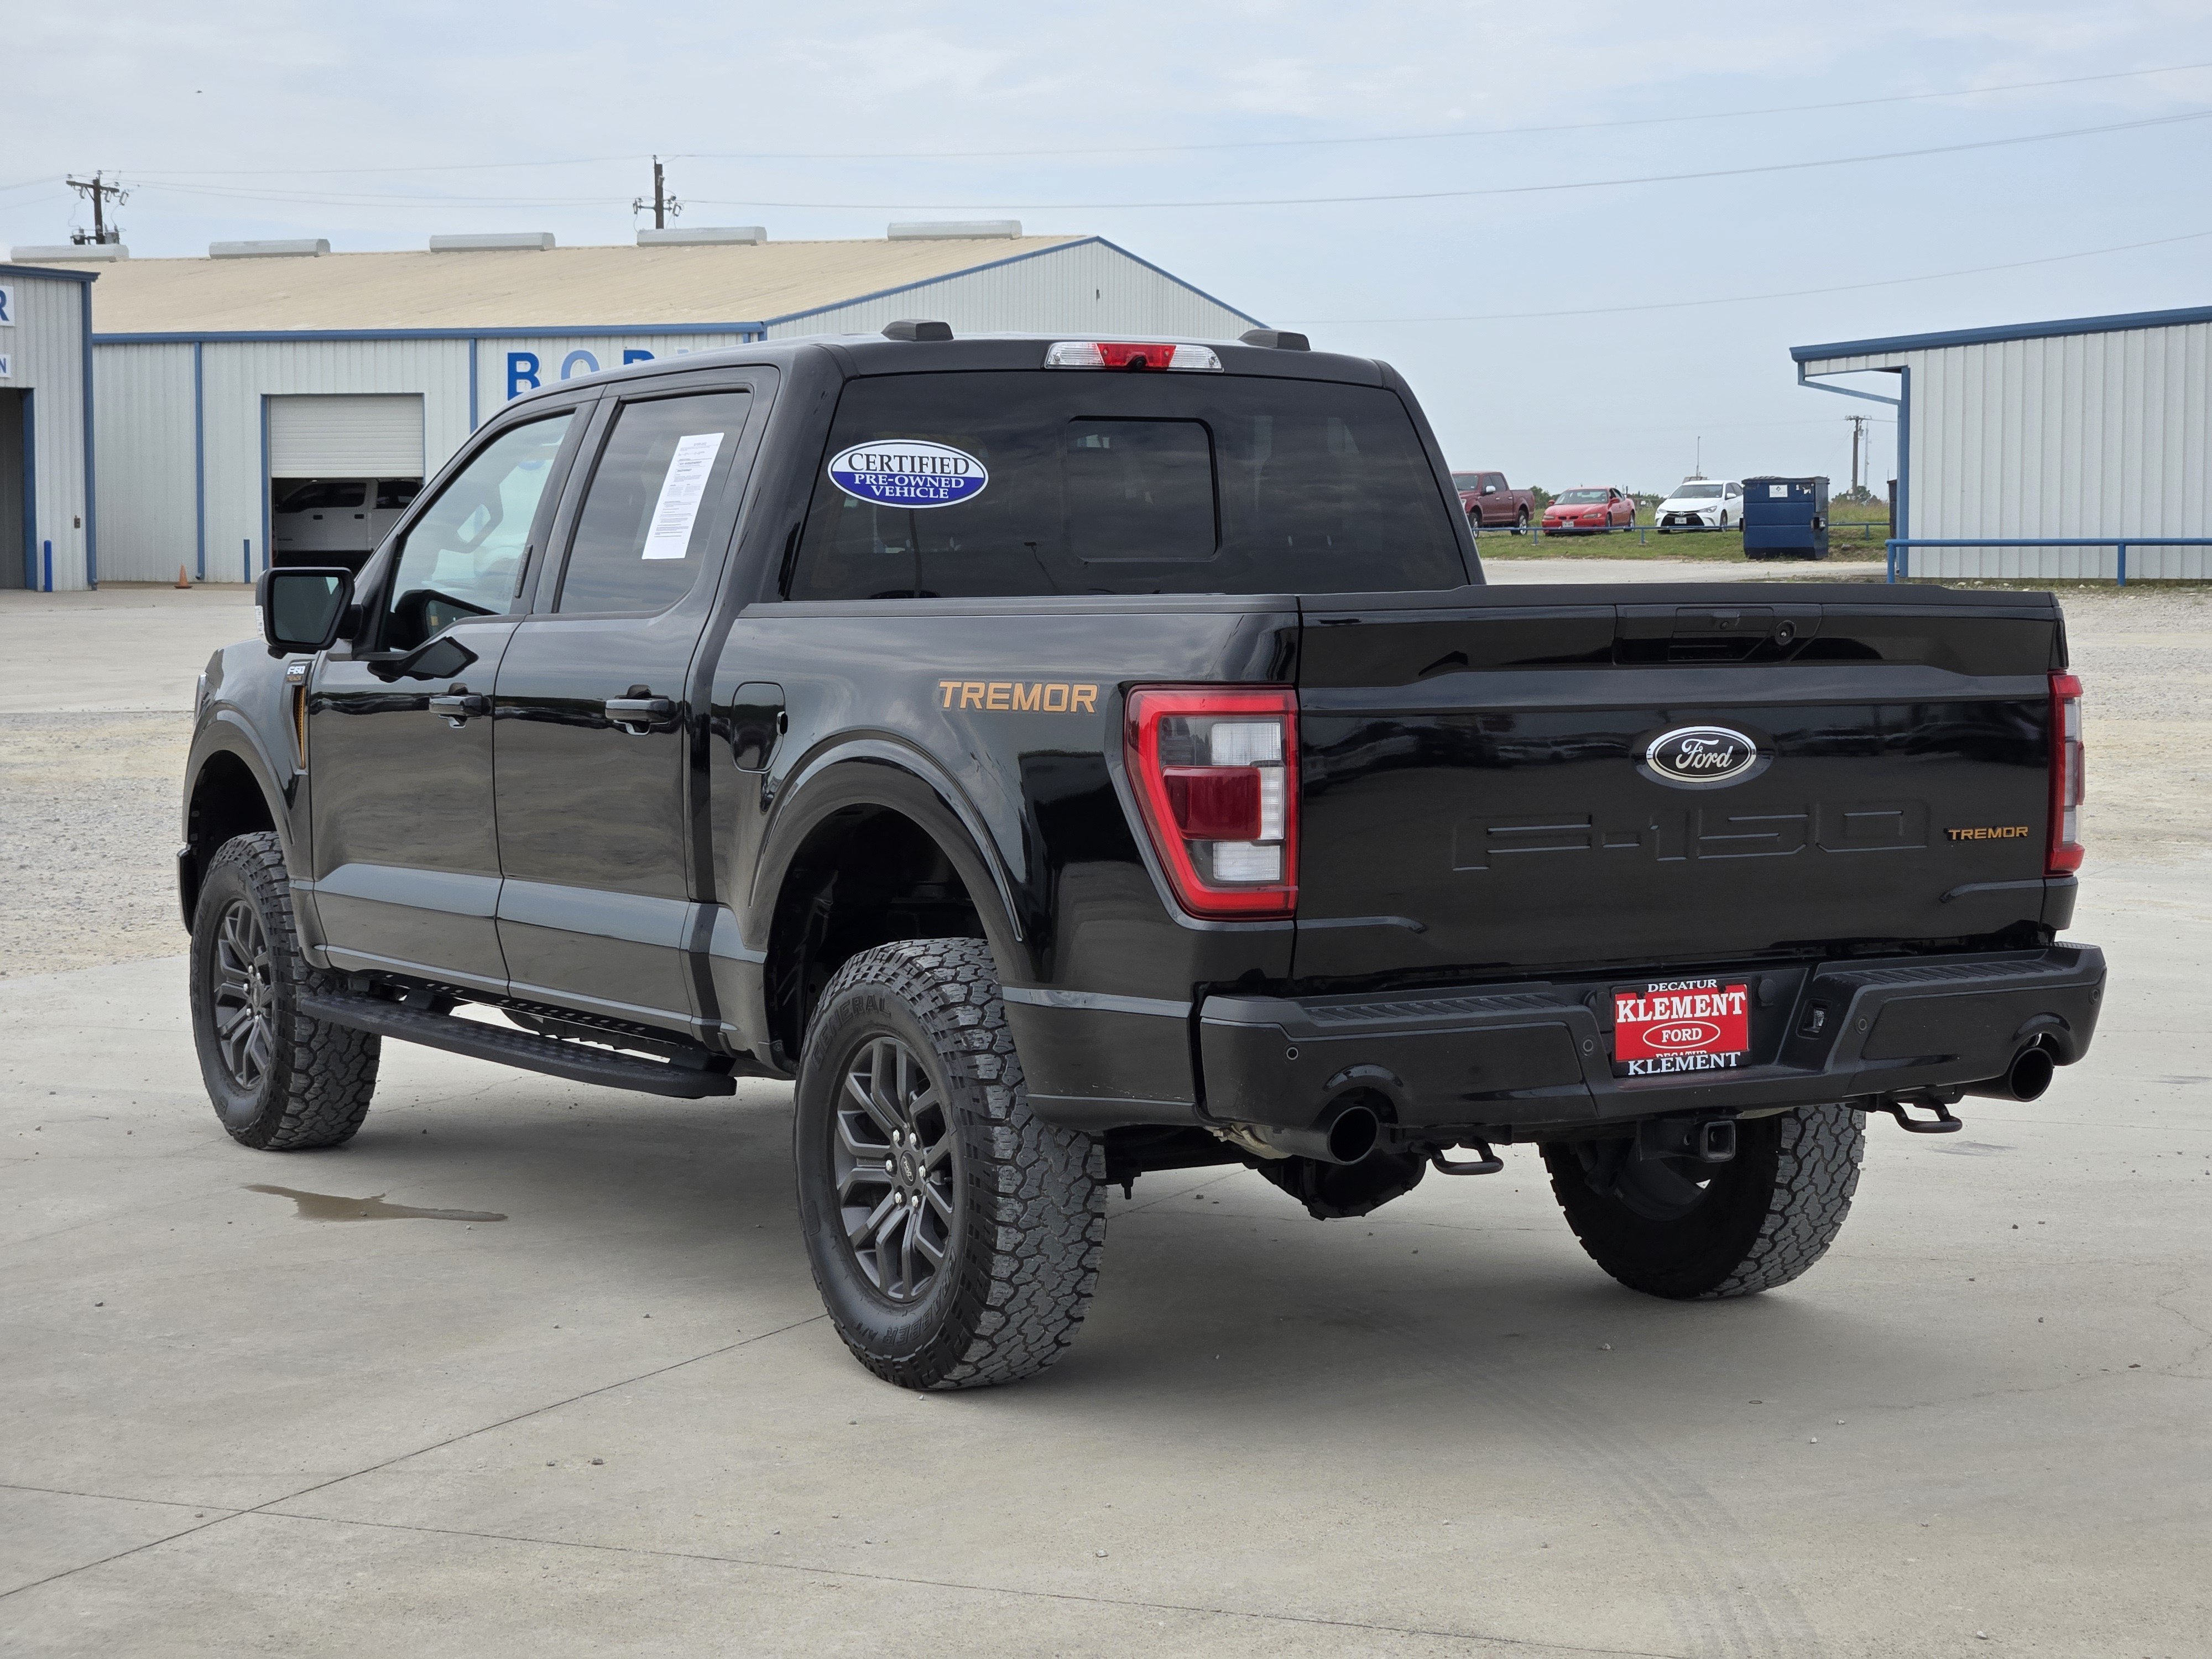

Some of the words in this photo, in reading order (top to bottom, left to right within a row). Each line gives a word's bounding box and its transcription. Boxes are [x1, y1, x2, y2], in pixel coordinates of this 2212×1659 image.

[848, 453, 969, 475] CERTIFIED
[854, 473, 964, 488] PRE-OWNED
[871, 486, 949, 499] VEHICLE
[940, 681, 1098, 713] TREMOR
[1676, 738, 1734, 769] Ford
[1948, 826, 2028, 840] TREMOR
[1647, 979, 1718, 993] DECATUR
[1616, 992, 1746, 1023] KLEMENT
[811, 995, 893, 1070] GENERAL
[1661, 1028, 1702, 1042] FORD
[1627, 1051, 1741, 1076] KLEMENT
